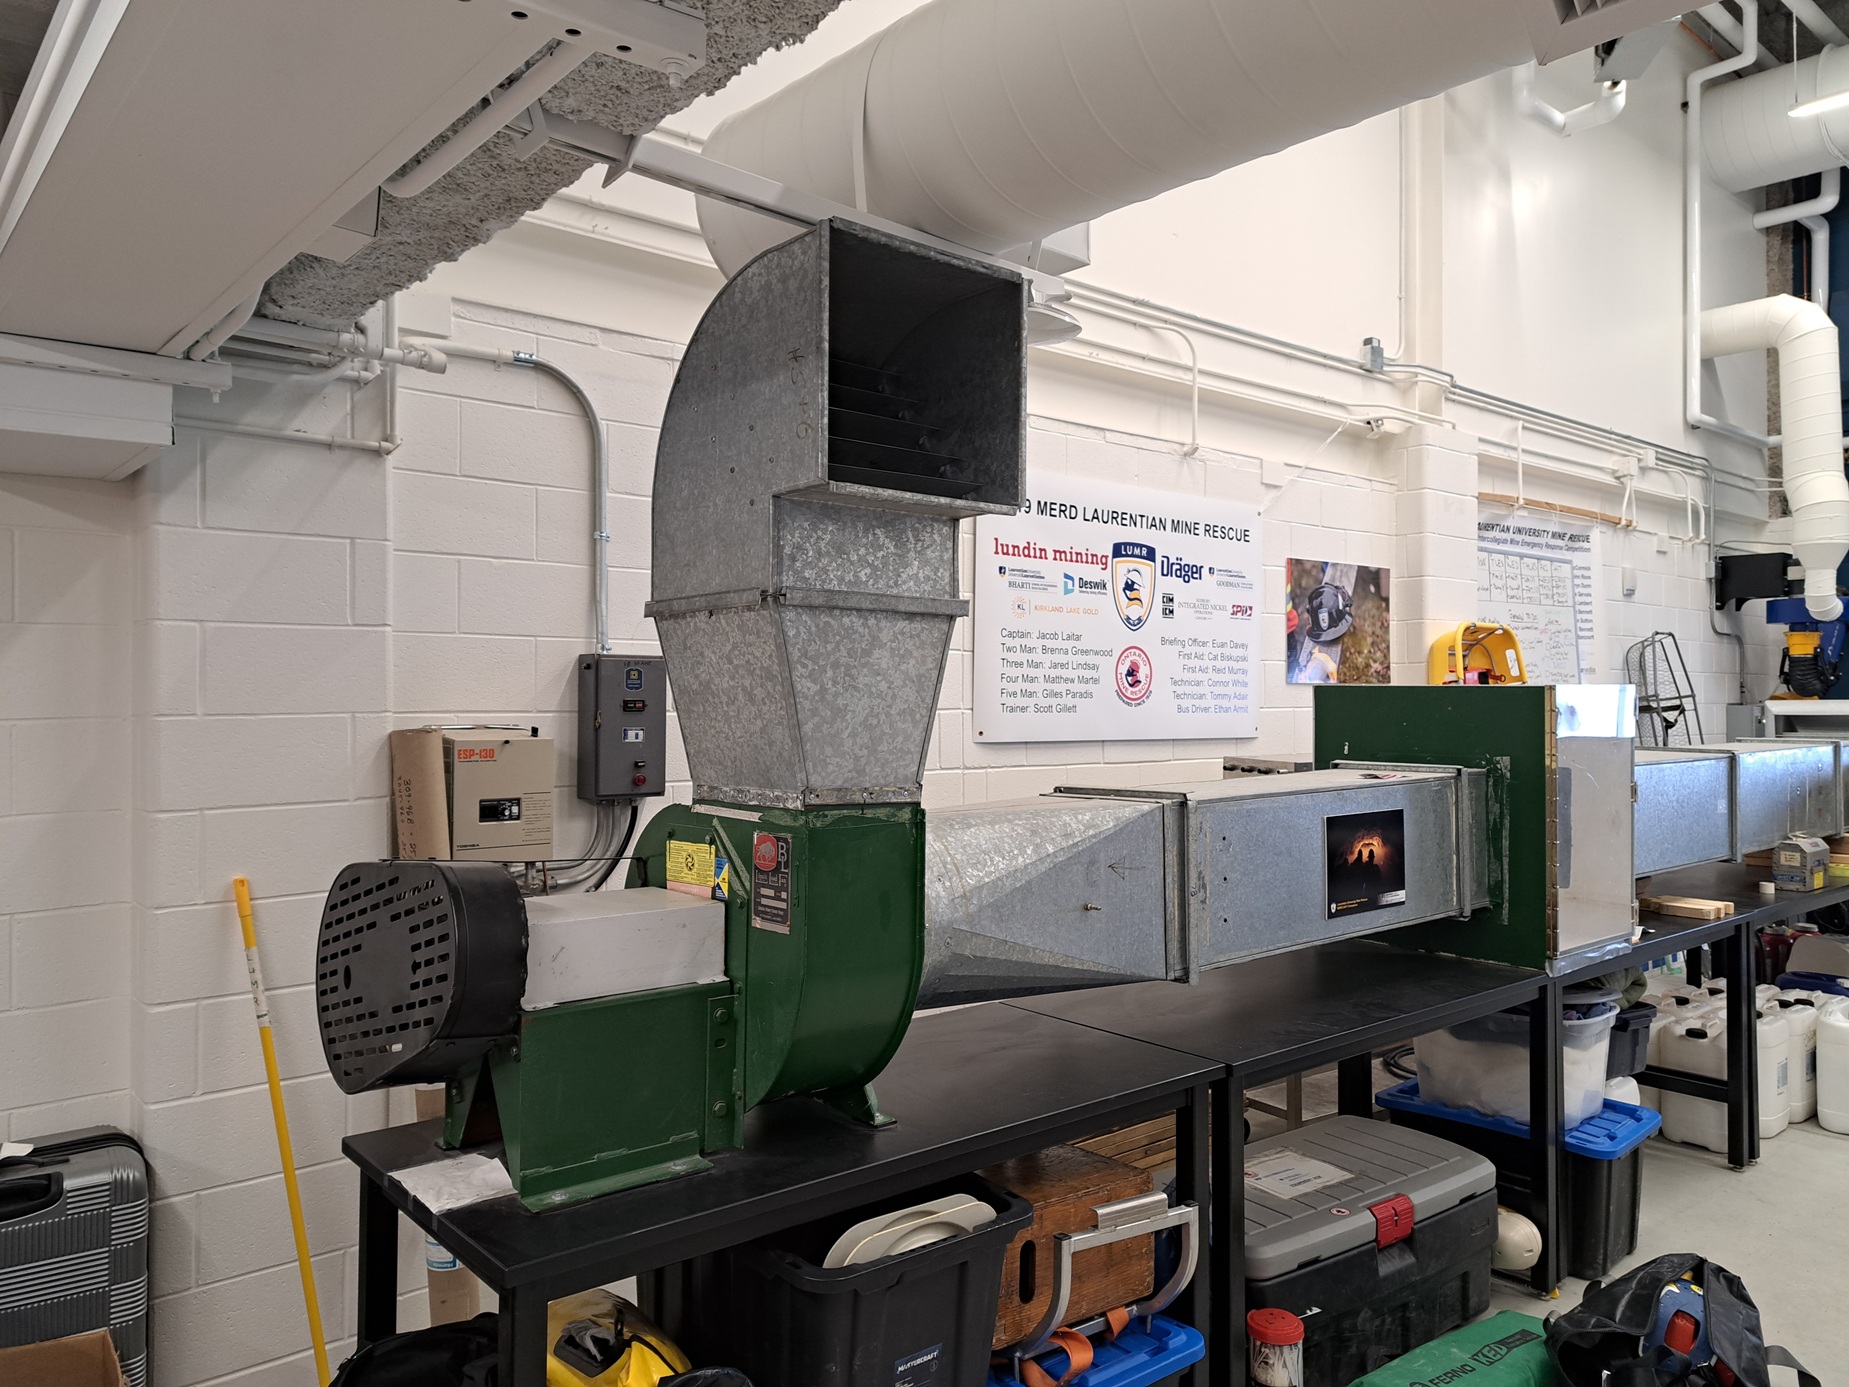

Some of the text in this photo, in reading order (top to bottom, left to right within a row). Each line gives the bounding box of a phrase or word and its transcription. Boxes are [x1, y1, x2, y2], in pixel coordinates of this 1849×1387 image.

[1037, 500, 1078, 520] MERD
[1083, 506, 1167, 532] LAURENTIAN
[1171, 519, 1200, 537] MINE
[1204, 524, 1251, 543] RESCUE
[1512, 526, 1550, 539] UNIVERSITY
[1551, 531, 1567, 541] MINE
[994, 537, 1109, 570] lundin mining
[1121, 544, 1148, 557] LUMR
[1161, 555, 1204, 584] Dräger
[1079, 577, 1107, 591] Deswik
[1034, 605, 1064, 613] KIRKLAND
[1178, 601, 1228, 612] INTEGRATED NICKEL
[1000, 628, 1082, 641] Captain: Jacob Laitar
[1001, 643, 1113, 657] Two Man: Brenna Greenwood
[1160, 637, 1248, 651] Briefing Officer: Euan Davey
[1120, 651, 1147, 667] ONTARIO
[1178, 651, 1249, 663] First Aid: Cat Biskupski
[1001, 658, 1100, 673] Three Man: Jared Lindsay
[1182, 664, 1249, 676] First Aid: Reid Murray
[1001, 673, 1100, 685] Four Man: Matthew Martel
[1119, 672, 1149, 697] MINE RESCUE
[1170, 677, 1249, 688] Technician: Connor White
[1001, 688, 1094, 699] Five Man: Gilles Paradis
[1172, 691, 1248, 702] Technician: Tommy Adair
[1001, 703, 1077, 714] Trainer: Scott Gillett
[1177, 704, 1249, 714] Bus Driver: Ethan Armit
[457, 748, 495, 760] ESP-130
[1474, 1343, 1508, 1366] KED
[1428, 1363, 1477, 1387] FERNO
